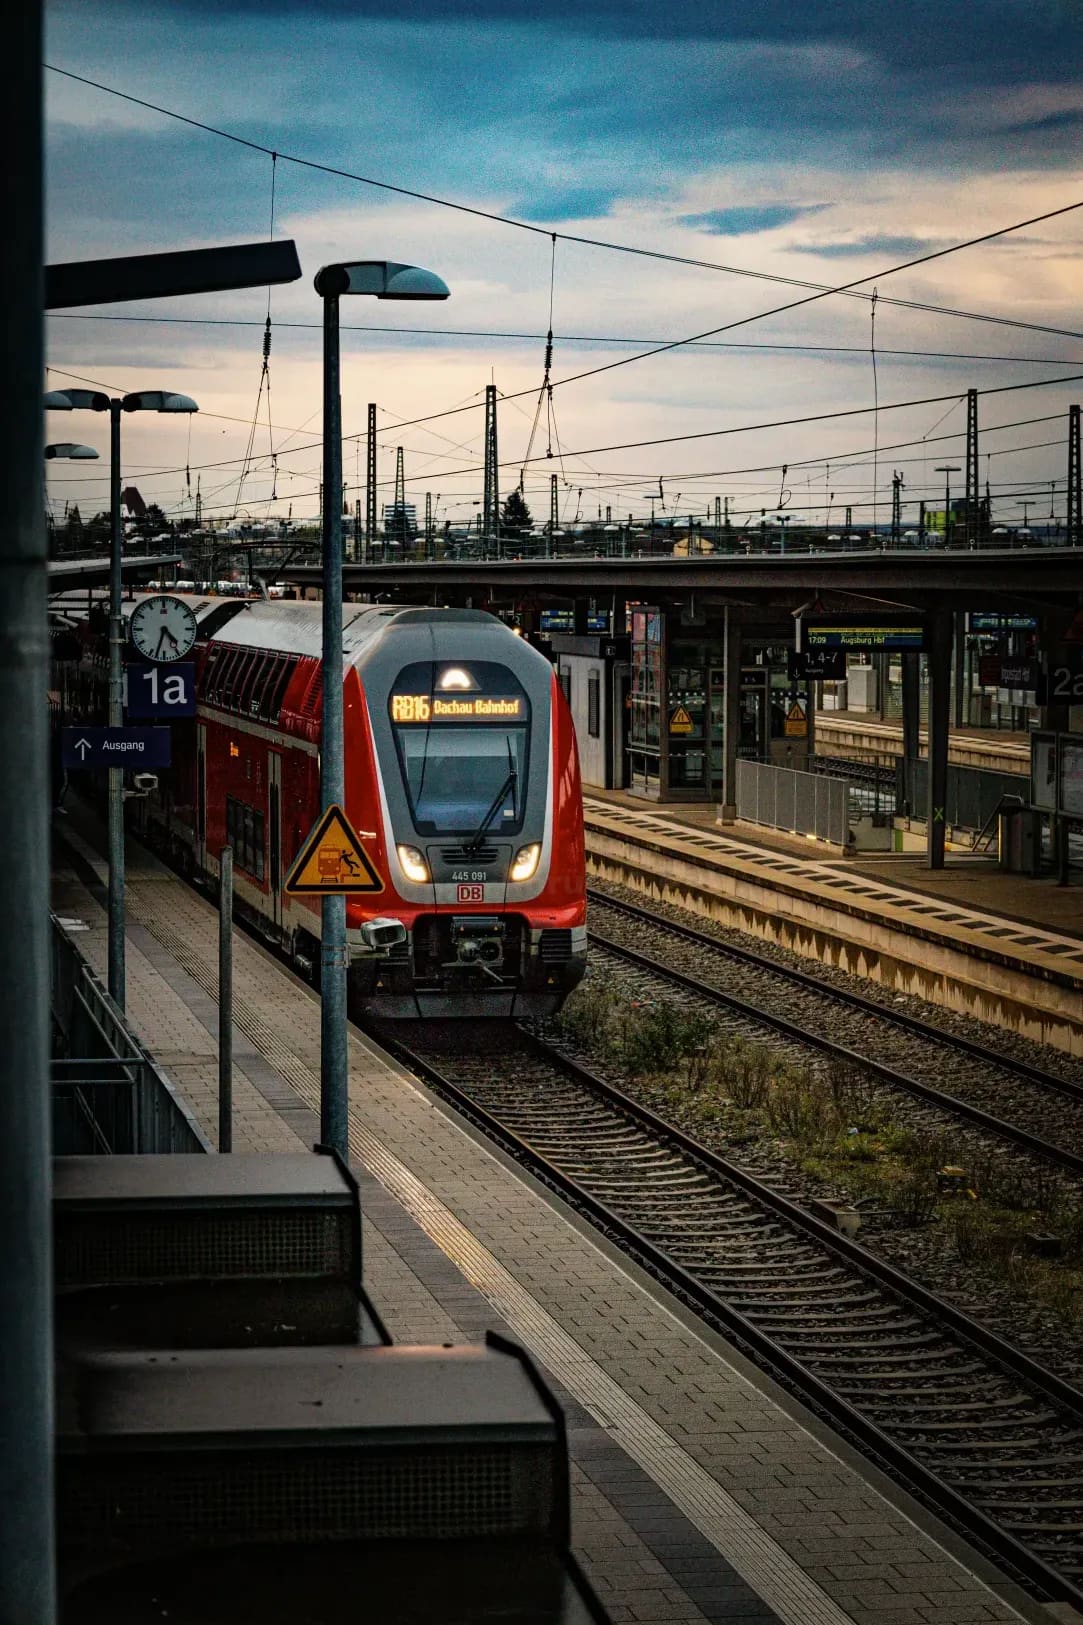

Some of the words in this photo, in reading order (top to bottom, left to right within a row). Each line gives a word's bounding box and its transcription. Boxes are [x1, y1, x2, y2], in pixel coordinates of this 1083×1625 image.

[840, 636, 872, 646] Augsburg
[874, 636, 885, 644] Hbf
[143, 668, 188, 705] 1a
[392, 695, 430, 721] RB16
[434, 701, 473, 714] Dachau
[475, 699, 520, 714] Bahnhof
[102, 740, 145, 752] Ausgang
[451, 871, 469, 881] 445
[471, 871, 487, 881] 091
[460, 887, 482, 900] DB
